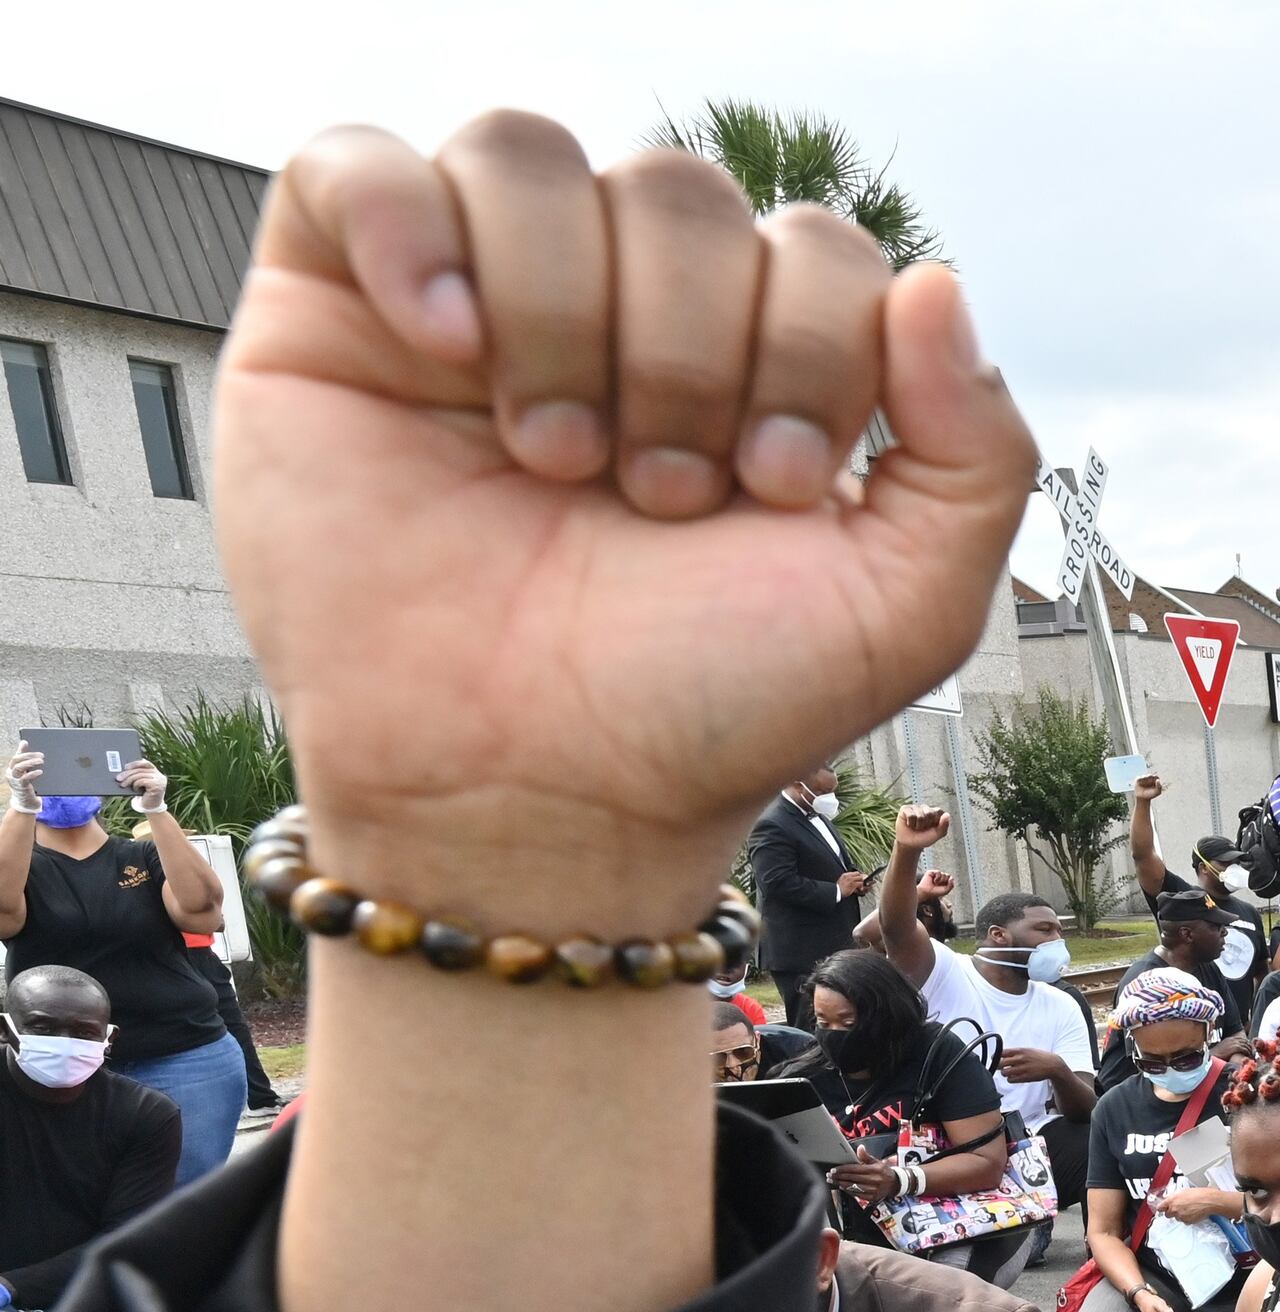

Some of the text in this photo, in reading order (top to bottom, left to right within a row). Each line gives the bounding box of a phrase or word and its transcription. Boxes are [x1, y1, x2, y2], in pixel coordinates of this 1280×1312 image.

[1062, 455, 1104, 595] CROSSING
[1090, 529, 1131, 590] ROAD
[1195, 645, 1215, 659] YIELD
